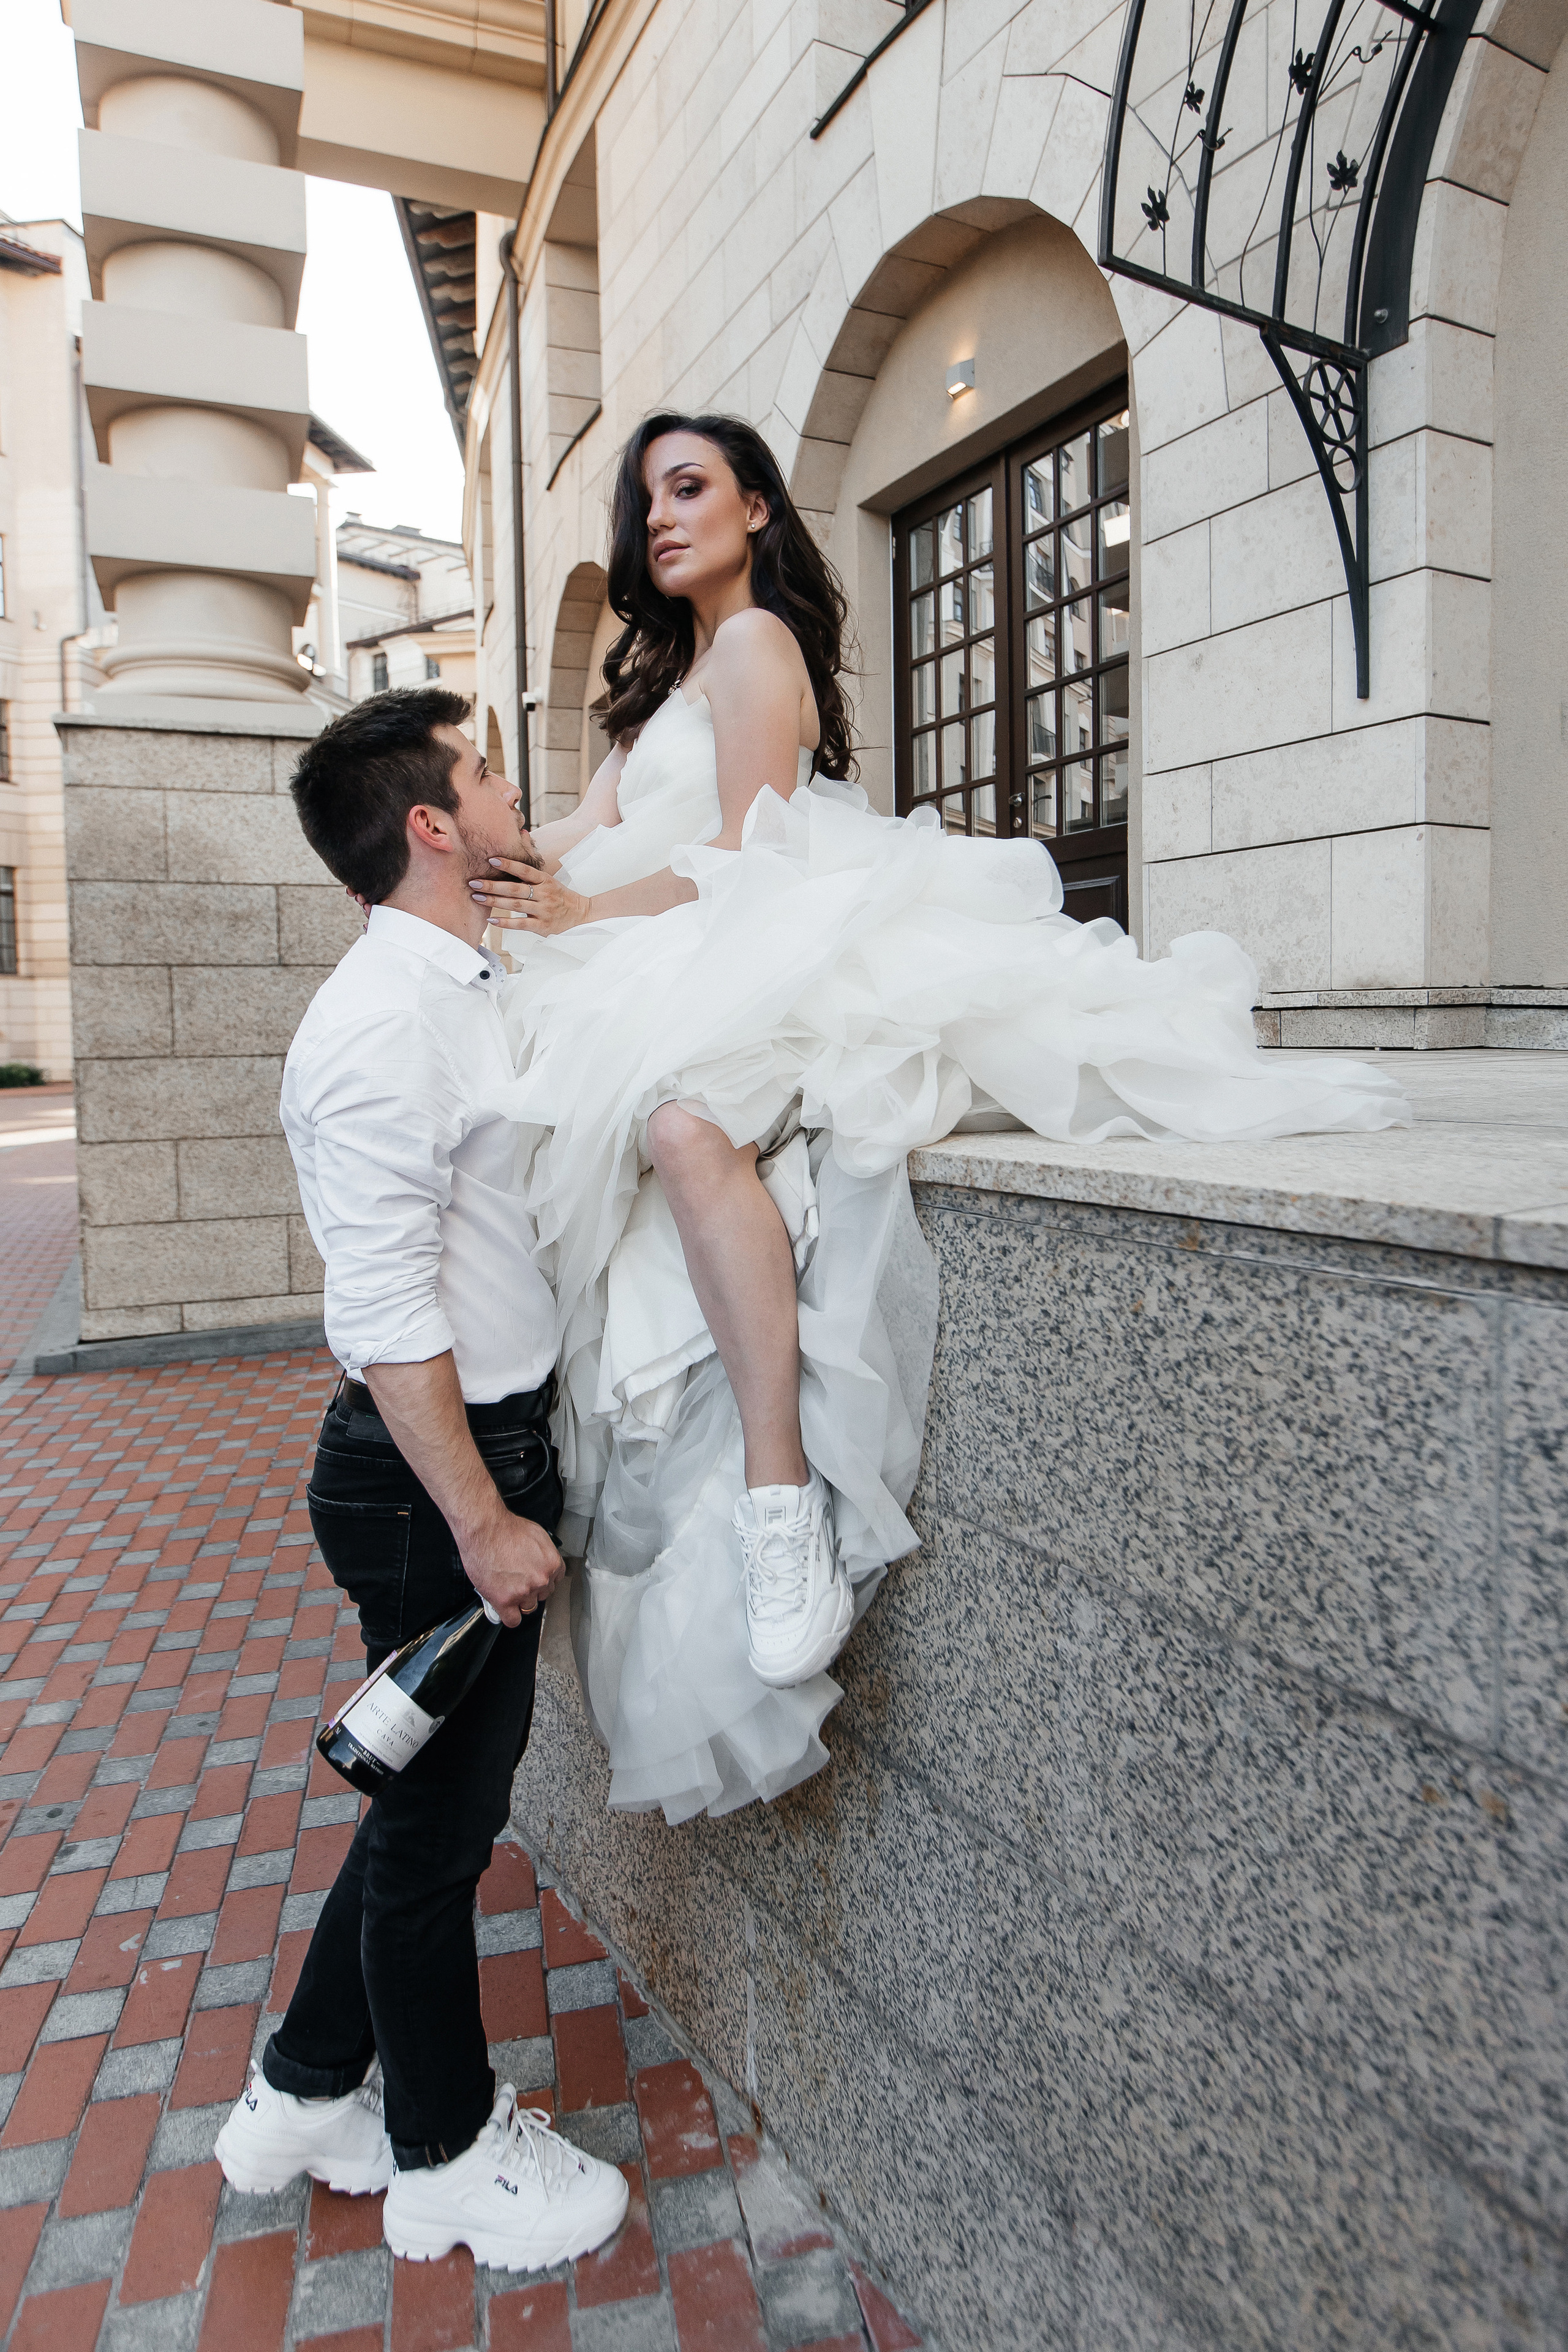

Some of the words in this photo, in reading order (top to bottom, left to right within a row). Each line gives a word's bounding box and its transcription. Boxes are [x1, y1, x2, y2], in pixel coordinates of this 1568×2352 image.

[367, 1702, 391, 1726] ARTE
[390, 1724, 419, 1749] LATINO
[377, 1728, 394, 1746] CAVA
[347, 1742, 371, 1765] TRADITIONAL
[363, 1749, 377, 1763] BRUT
[494, 2174, 518, 2195] FILA
